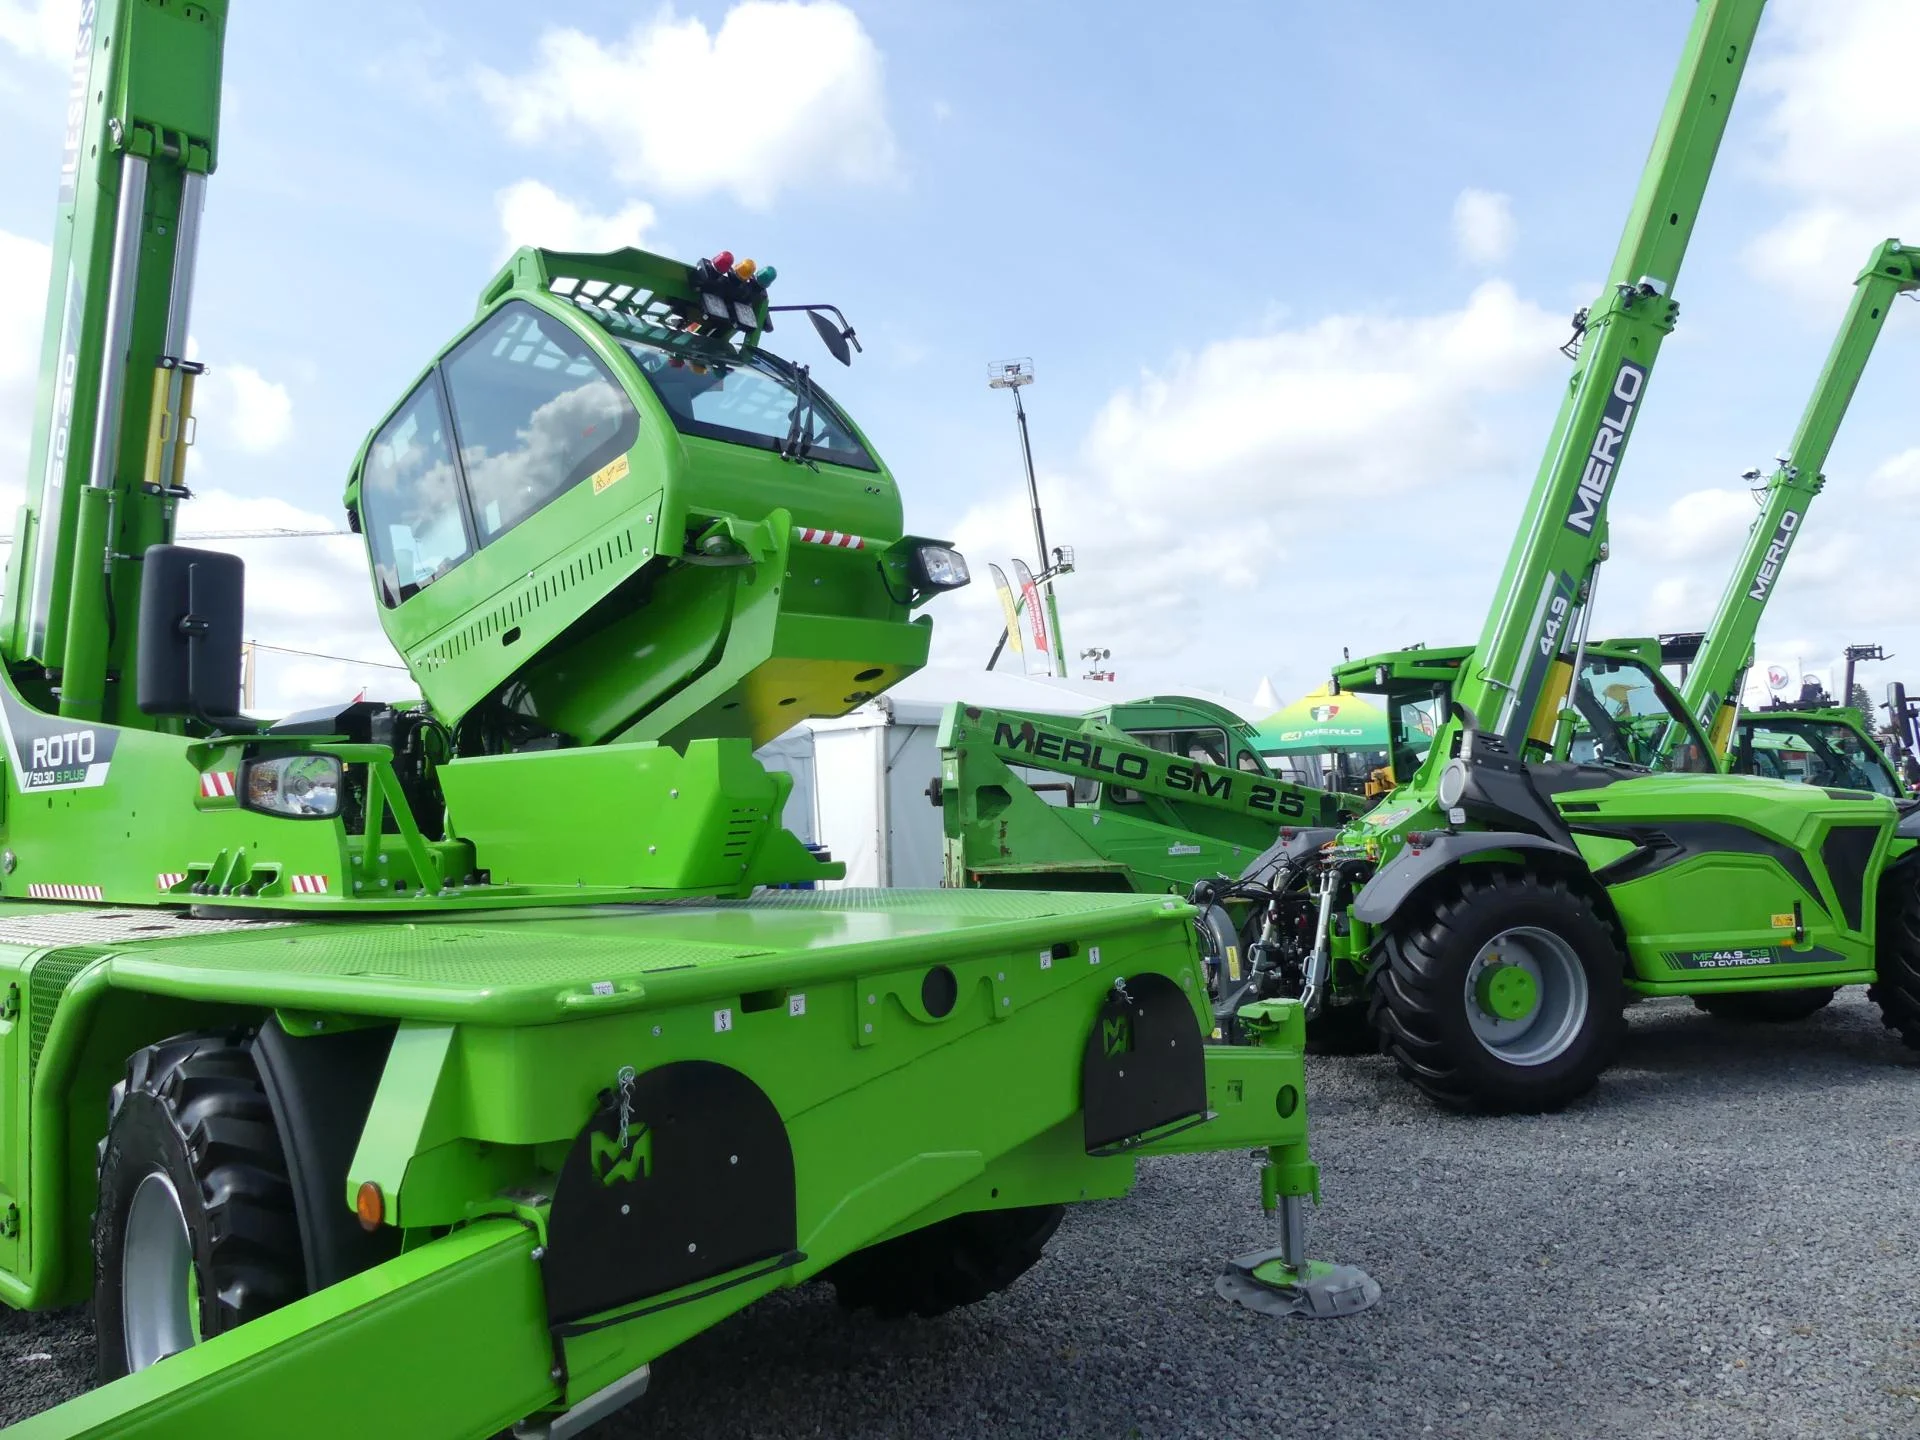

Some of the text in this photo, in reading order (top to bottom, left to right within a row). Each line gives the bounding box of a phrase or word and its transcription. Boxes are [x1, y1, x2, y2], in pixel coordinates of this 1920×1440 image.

[52, 354, 75, 488] 50.30
[1567, 364, 1643, 532] MERLO
[1749, 511, 1799, 601] MERLO
[1539, 596, 1568, 656] 44.9
[33, 730, 95, 769] ROTO
[1303, 728, 1363, 738] MERLO
[32, 768, 85, 785] 50.30 S PLUS
[993, 722, 1305, 818] MERLO SM 25
[1699, 957, 1771, 968] 170 CVTRONIC
